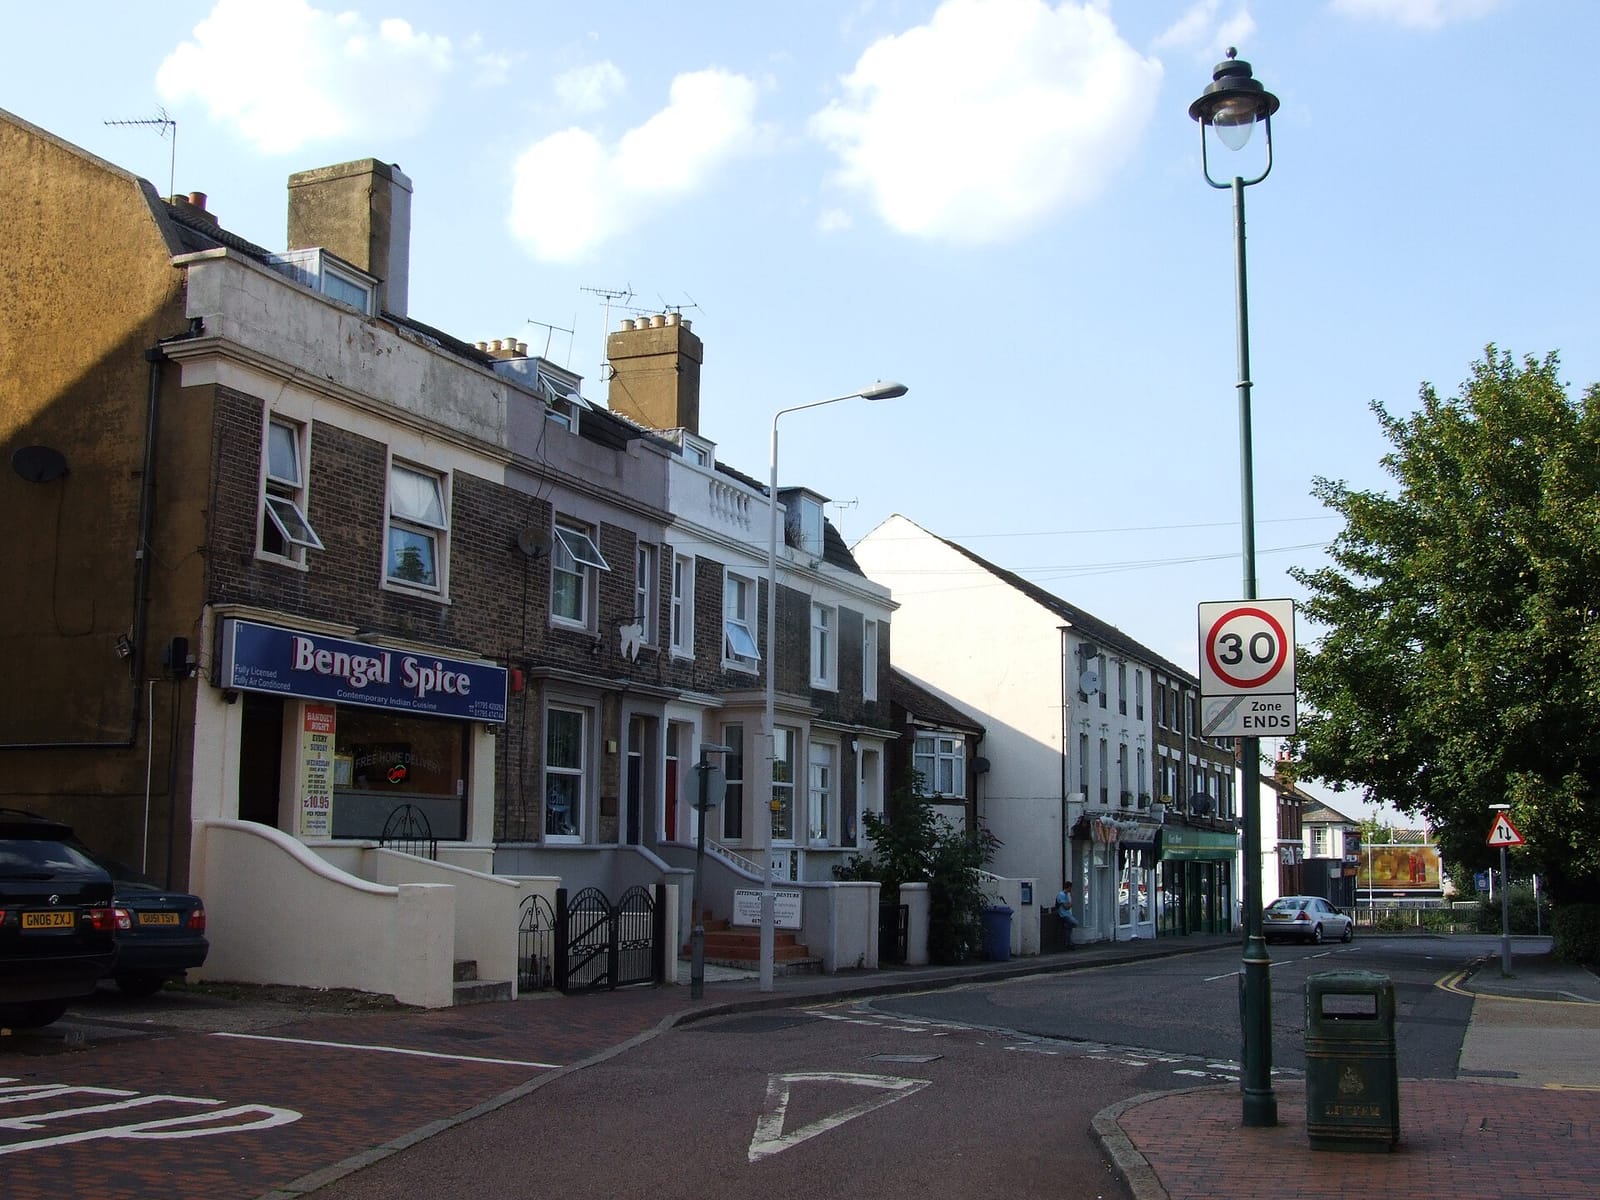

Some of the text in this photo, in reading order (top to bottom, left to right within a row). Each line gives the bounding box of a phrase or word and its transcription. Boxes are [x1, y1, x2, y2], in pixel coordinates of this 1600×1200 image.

[1219, 632, 1276, 665] 30
[235, 664, 278, 679] Fully Licensed
[292, 636, 471, 698] Bengal Spice
[234, 674, 291, 690] Fully Air Conditioned
[336, 689, 438, 710] Contemporary Indian Cuisine
[1251, 701, 1282, 711] Zone
[1243, 715, 1290, 728] ENDS
[312, 734, 328, 742] EVERY
[310, 743, 328, 752] SUNDAY
[355, 752, 441, 774] FREE HOME DELIVERY
[26, 913, 71, 926] GN06 ZXJ
